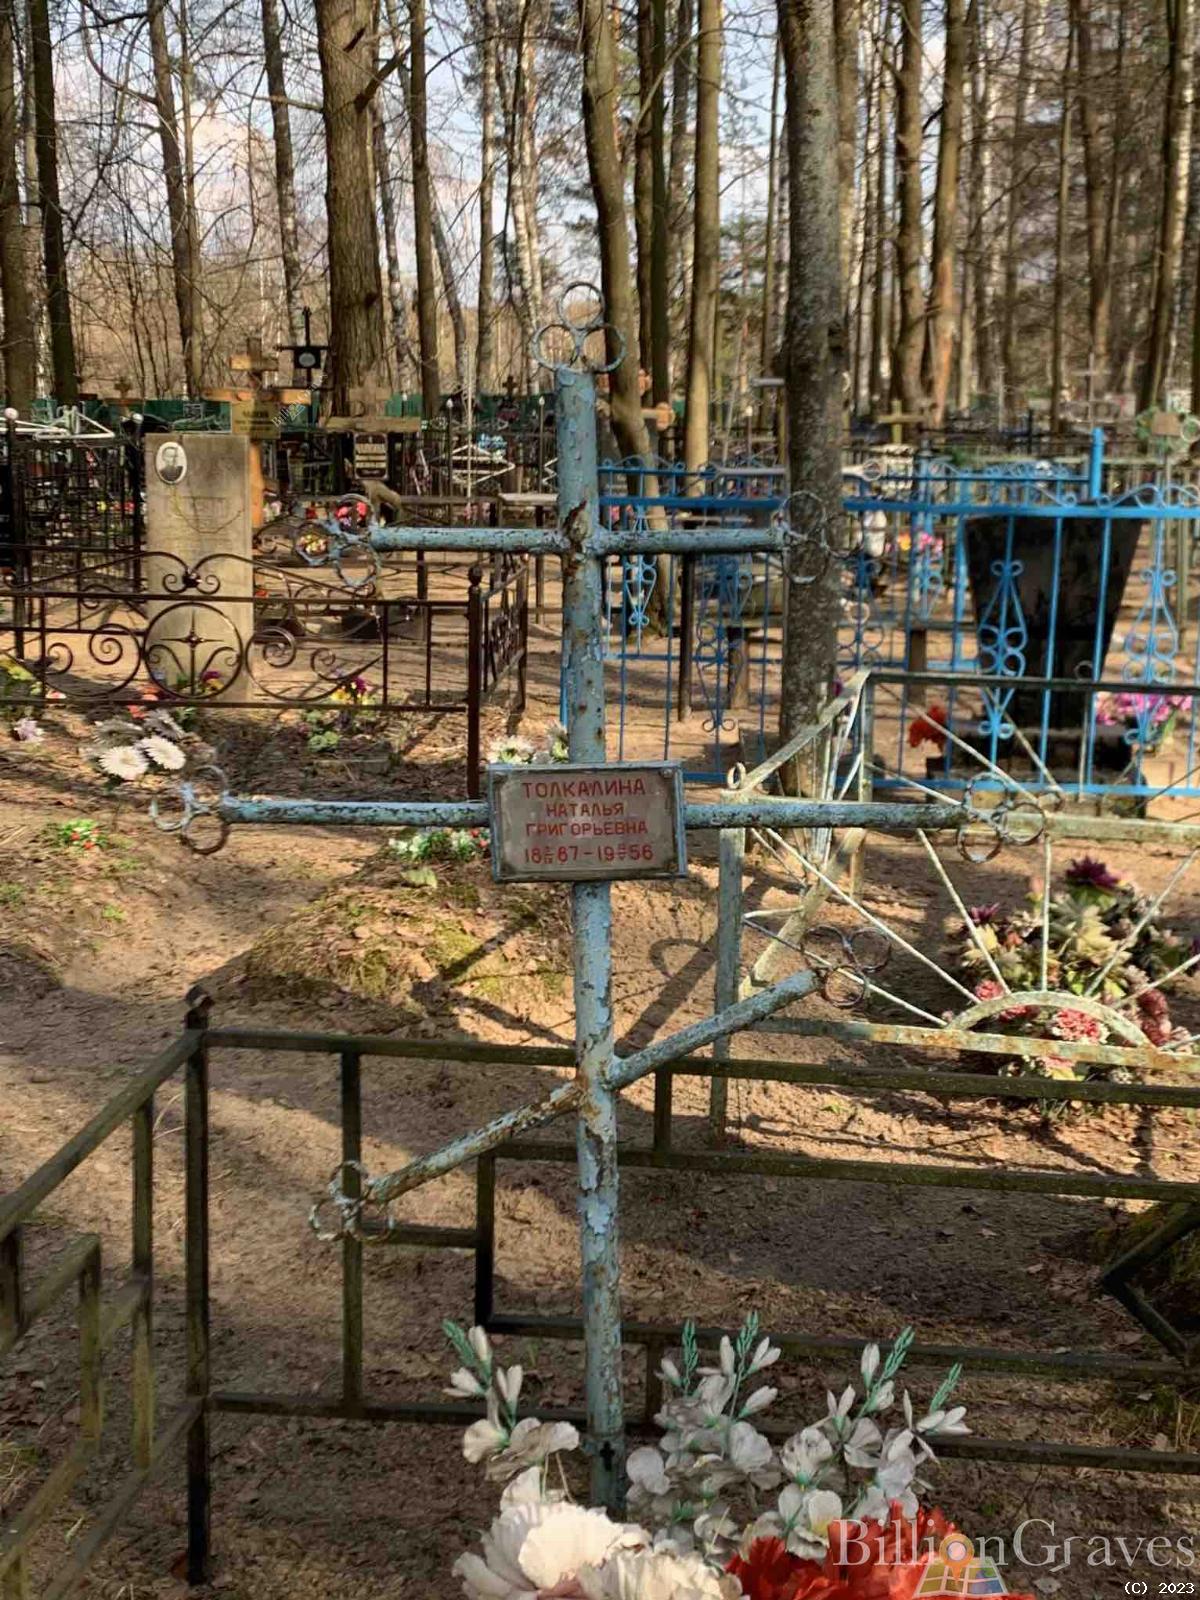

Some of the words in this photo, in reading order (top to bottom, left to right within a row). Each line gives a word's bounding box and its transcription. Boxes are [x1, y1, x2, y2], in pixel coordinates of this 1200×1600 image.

[522, 778, 646, 798] ТОЛКАЛИНА
[546, 803, 624, 817] НАТАЛЬЯ
[526, 821, 648, 836] ГРИГОРЬЕВНА
